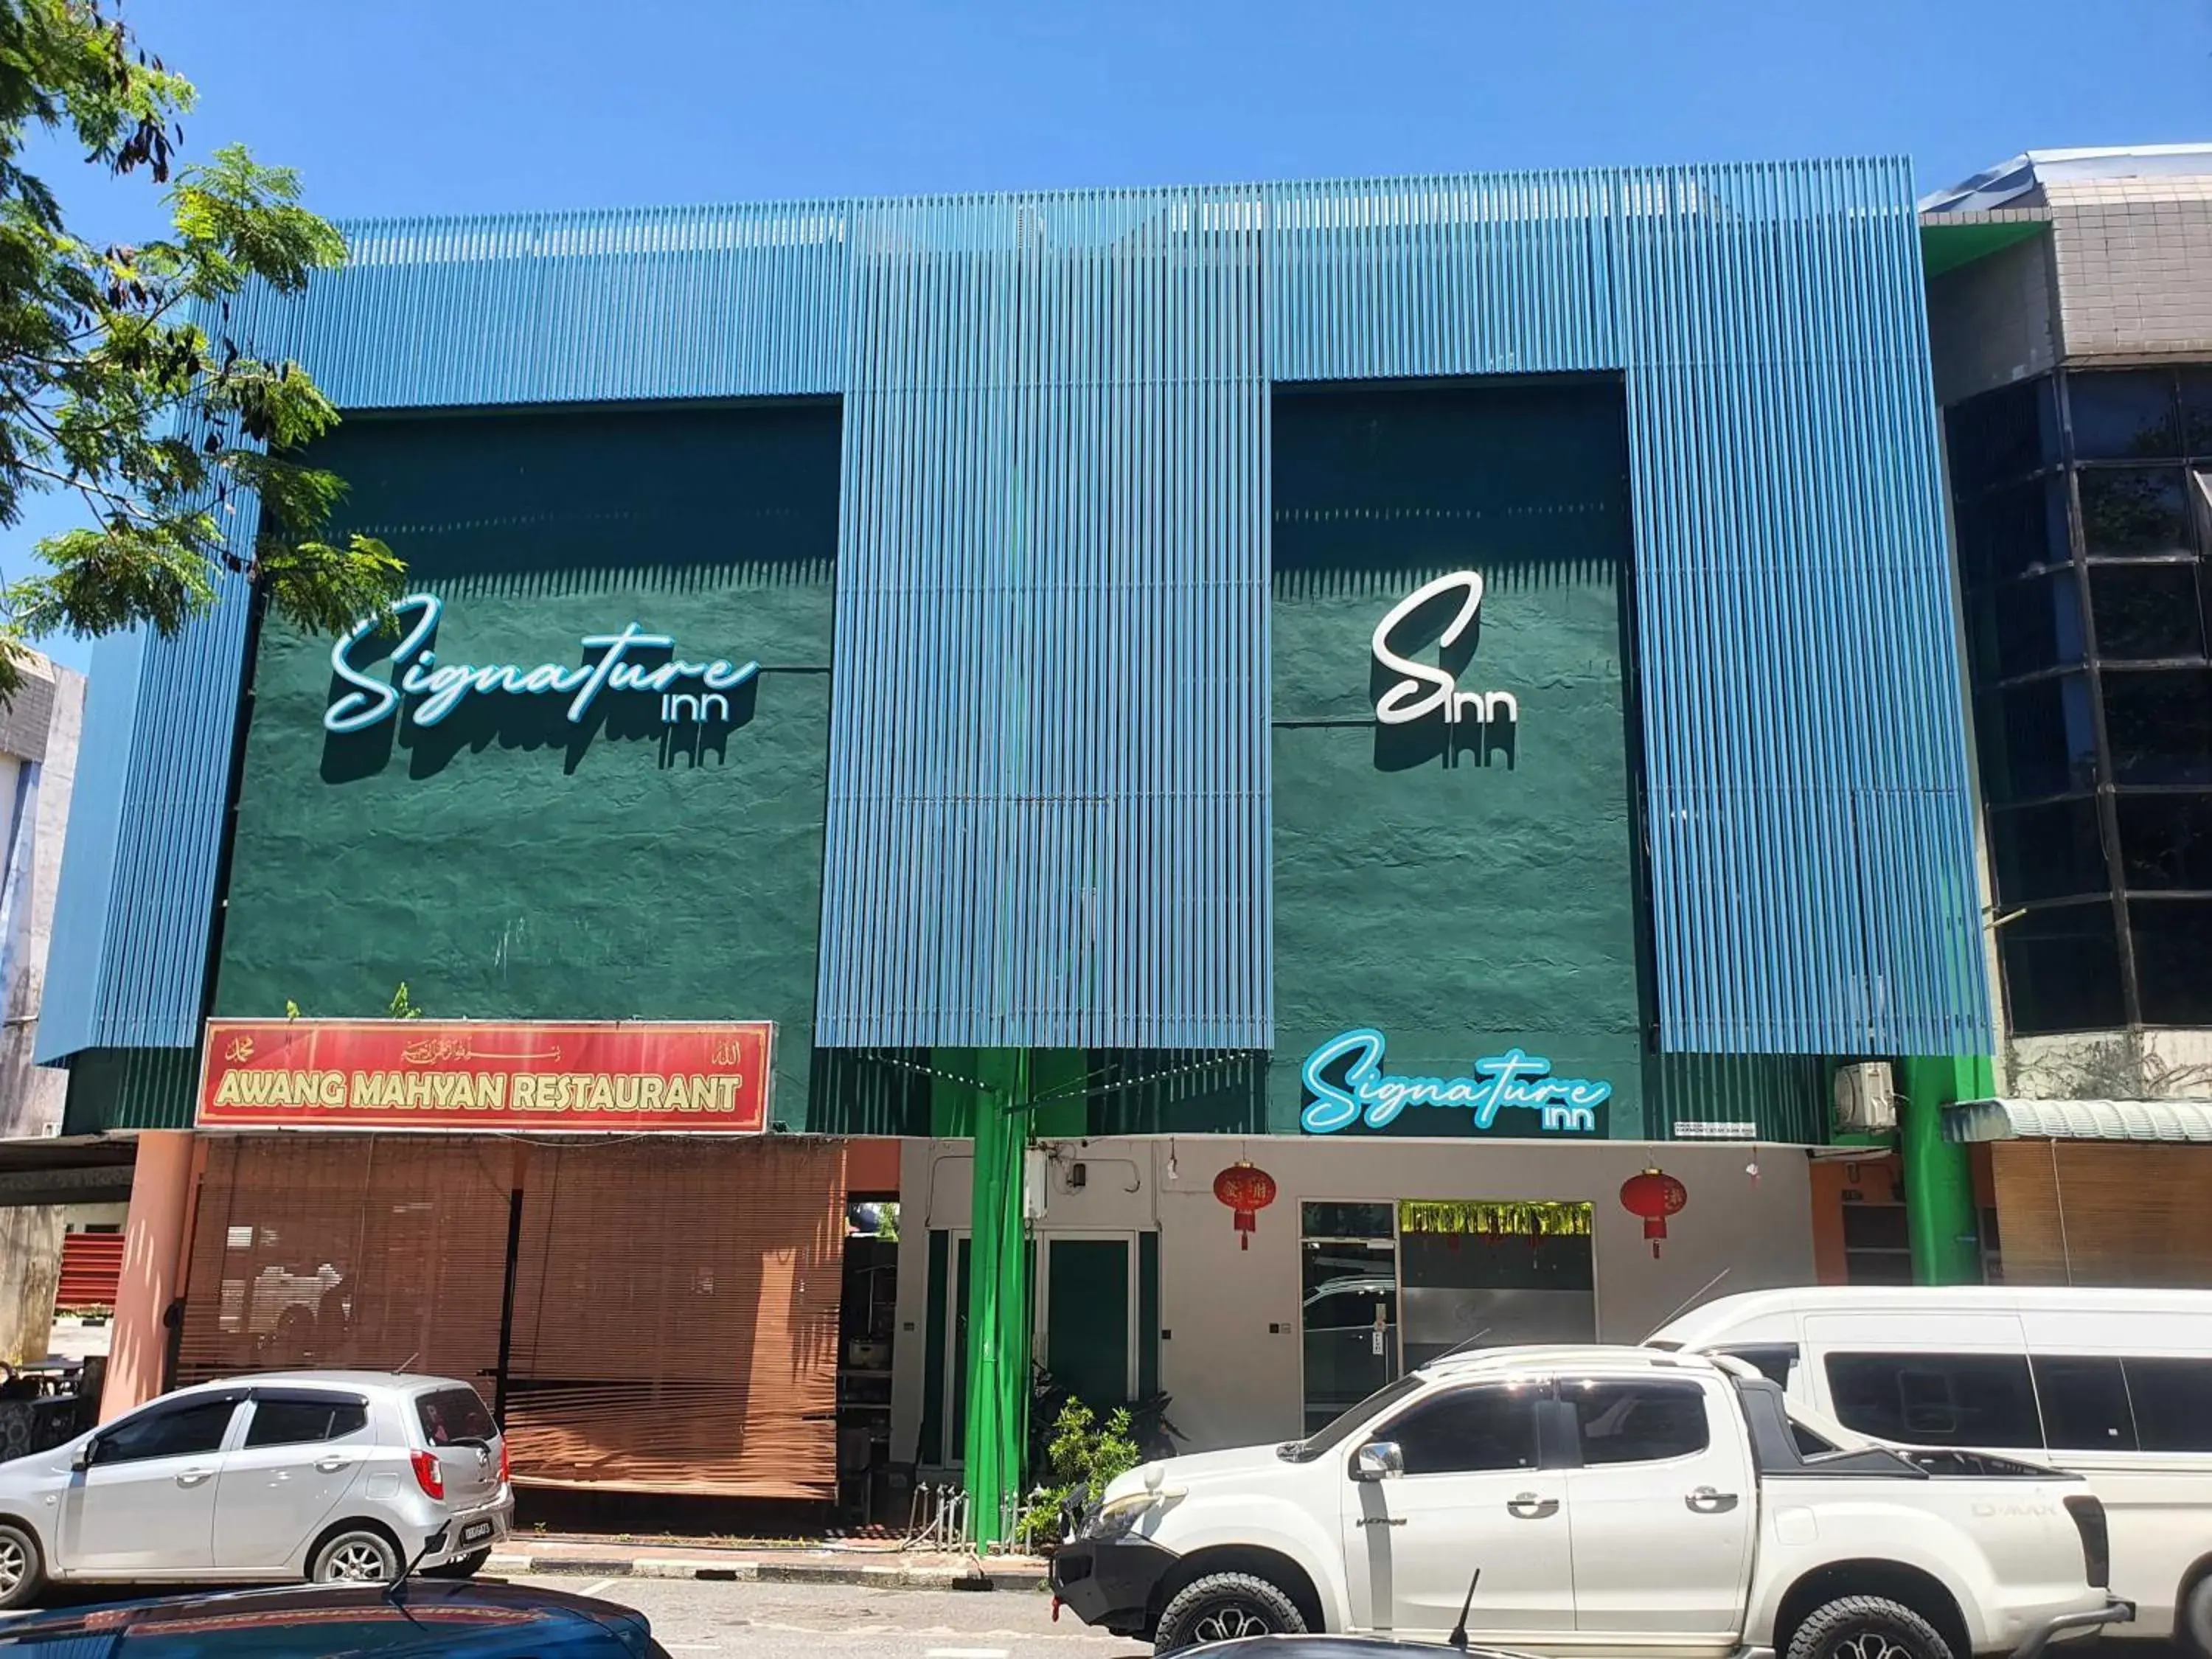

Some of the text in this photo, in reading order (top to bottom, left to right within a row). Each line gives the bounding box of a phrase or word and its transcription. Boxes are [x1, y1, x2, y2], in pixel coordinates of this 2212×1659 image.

[324, 592, 759, 732] Signature
[215, 1069, 741, 1112] AWANG MAHYAN RESTAURANT
[1301, 1029, 1612, 1133] Signature
